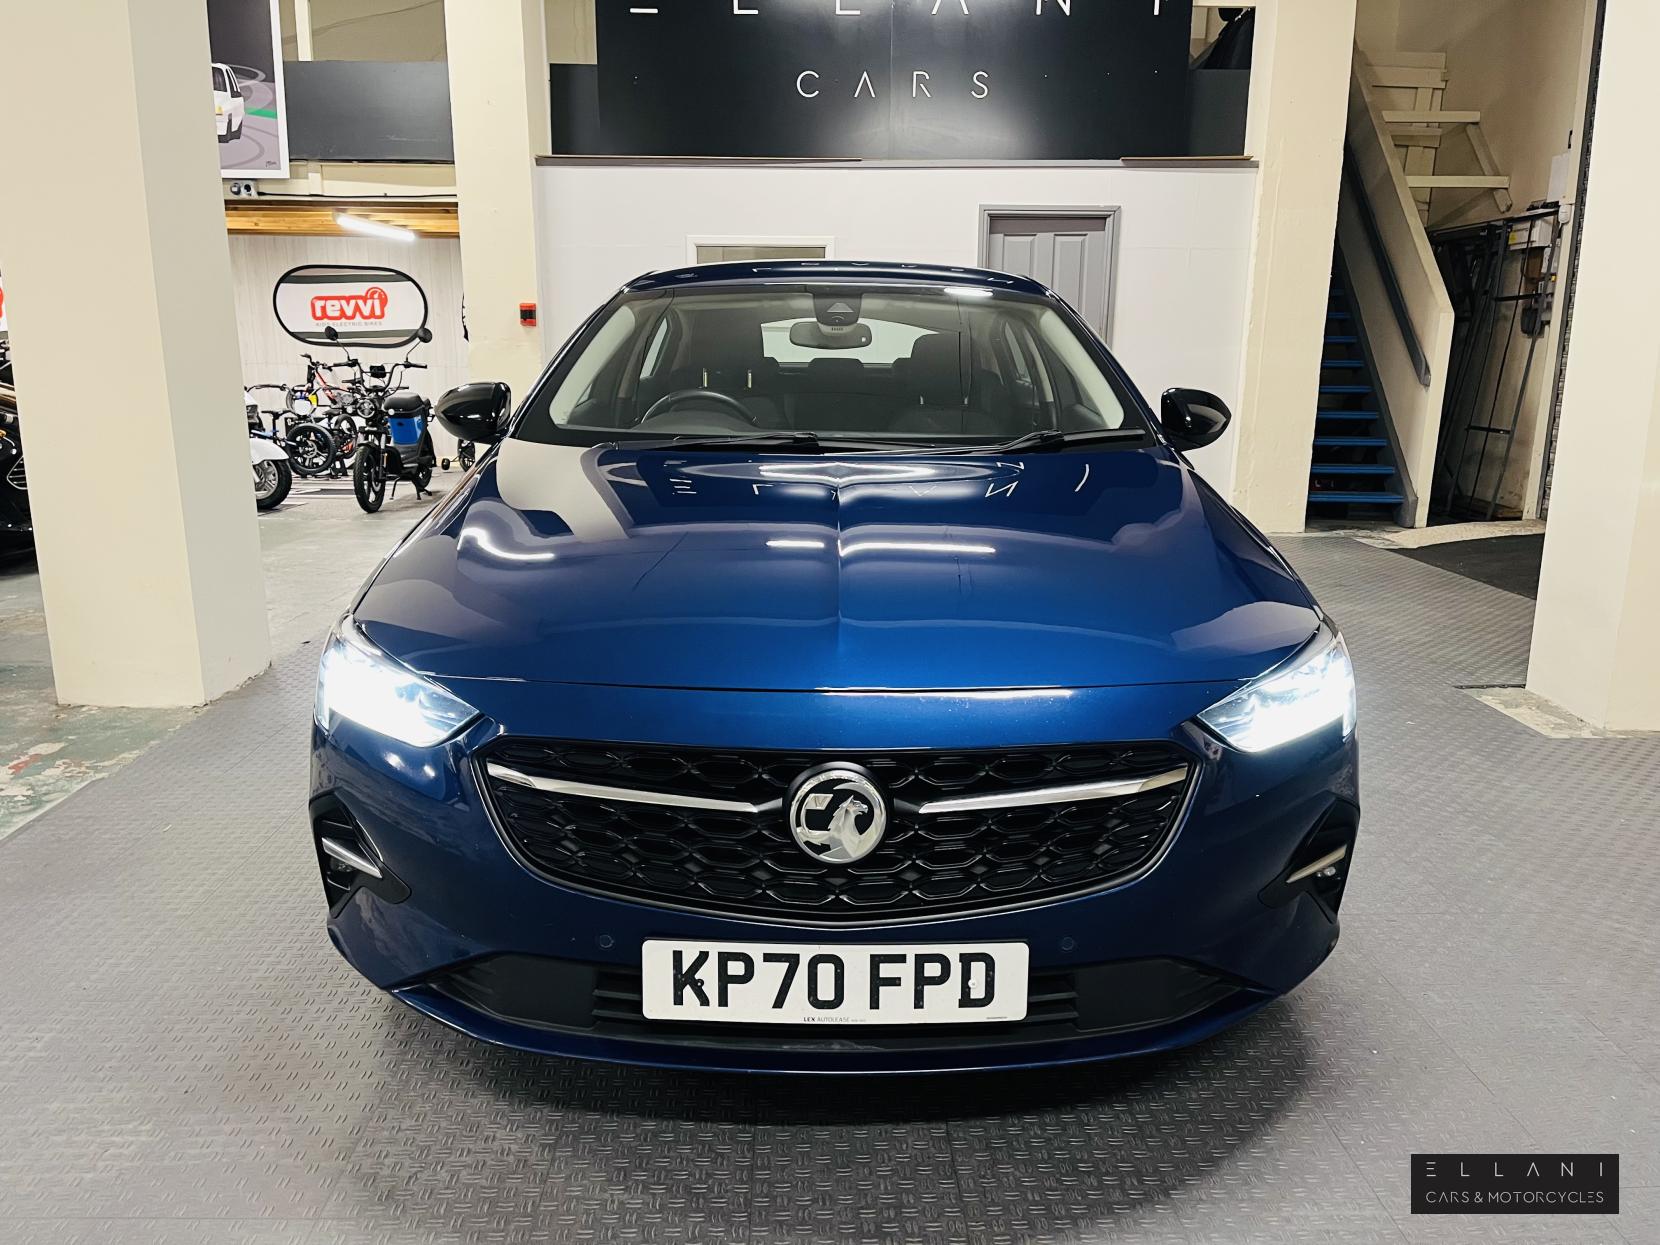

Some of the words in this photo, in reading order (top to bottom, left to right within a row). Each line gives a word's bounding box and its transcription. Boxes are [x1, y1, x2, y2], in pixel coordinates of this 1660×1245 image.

[796, 70, 989, 98] CARS
[312, 289, 382, 318] revvi
[672, 950, 845, 1009] KP70
[869, 952, 996, 1010] FPD
